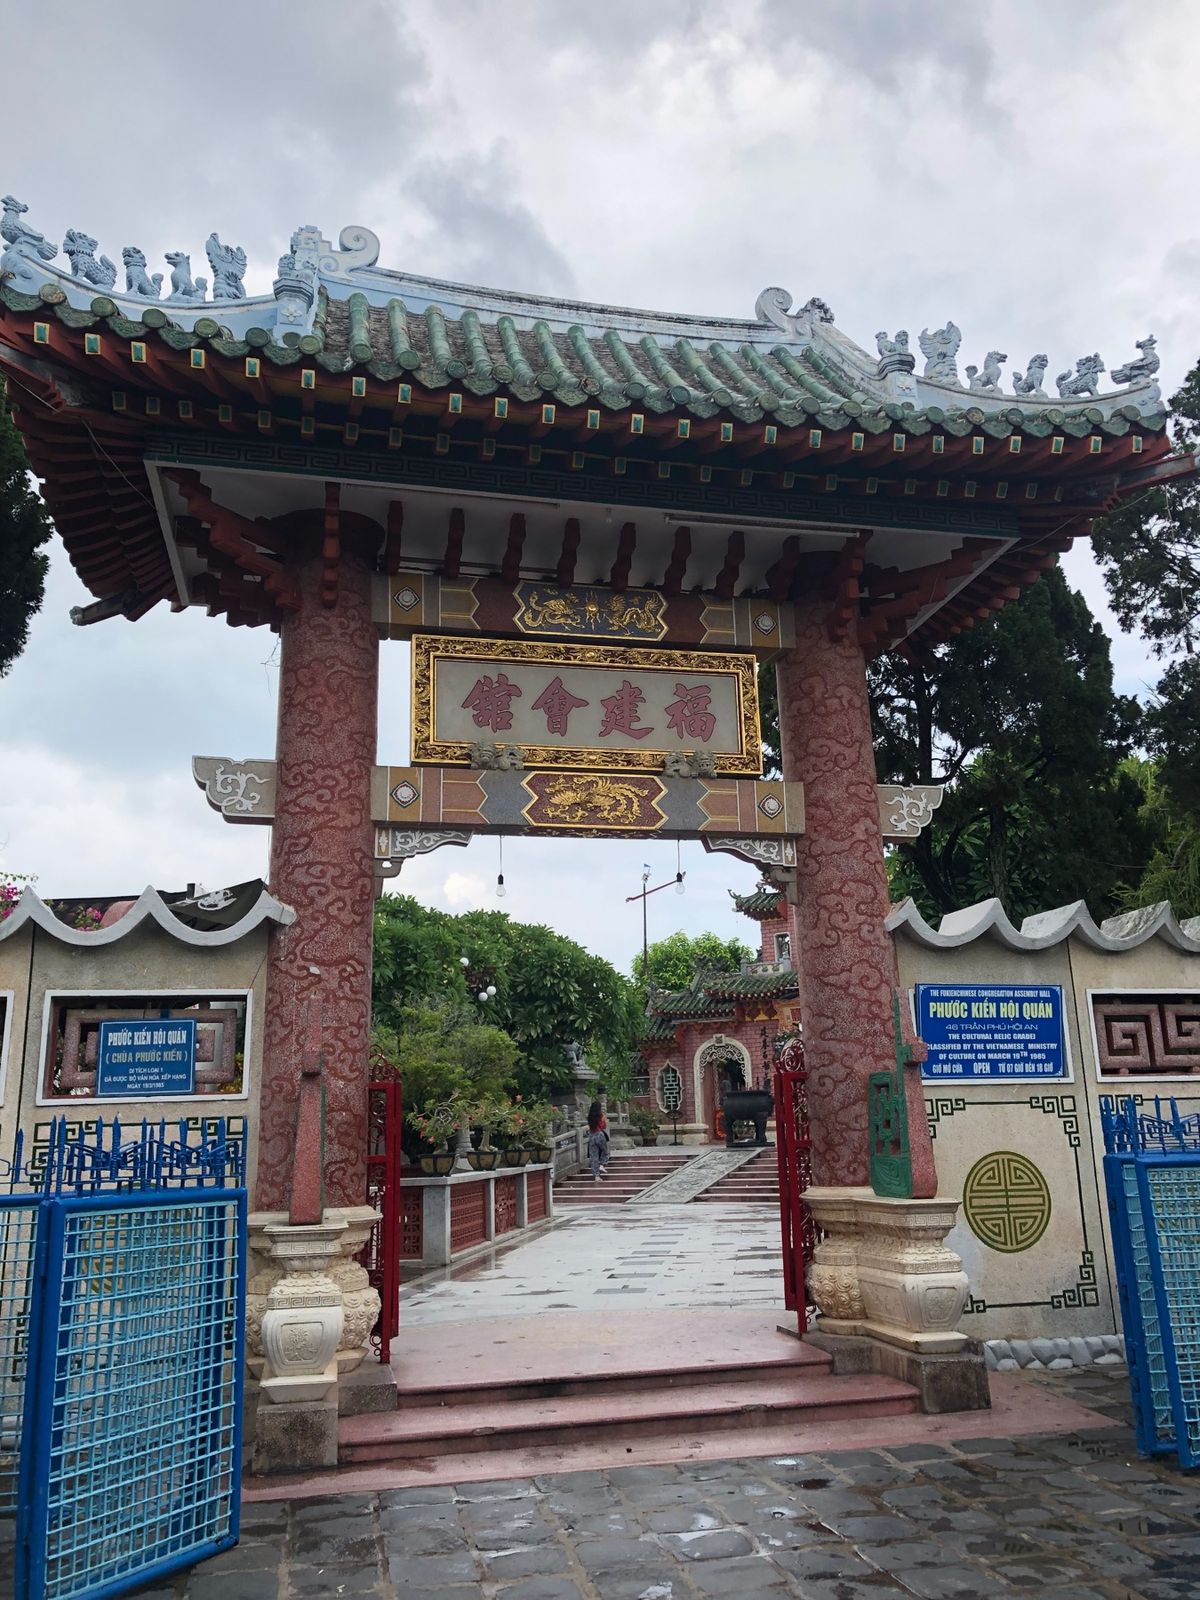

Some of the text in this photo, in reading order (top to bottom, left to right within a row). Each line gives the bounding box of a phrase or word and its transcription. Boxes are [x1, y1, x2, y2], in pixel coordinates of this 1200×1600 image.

[930, 989, 939, 997] THE
[978, 989, 1013, 997] CONGREGATION
[1014, 990, 1038, 998] ASSEMBLY
[1040, 990, 1050, 998] HALL
[929, 997, 1053, 1021] PHƯỚC KIẾN HỘI QUÁN
[986, 1022, 1007, 1030] PHÚ
[1007, 1023, 1023, 1031] HỘI
[108, 1026, 187, 1048] PHƯỚC KIẾN HỘI QUÁN
[135, 1049, 161, 1063] PHƯỚC
[163, 1048, 182, 1062] KIẾN
[973, 1062, 991, 1074] OPEN
